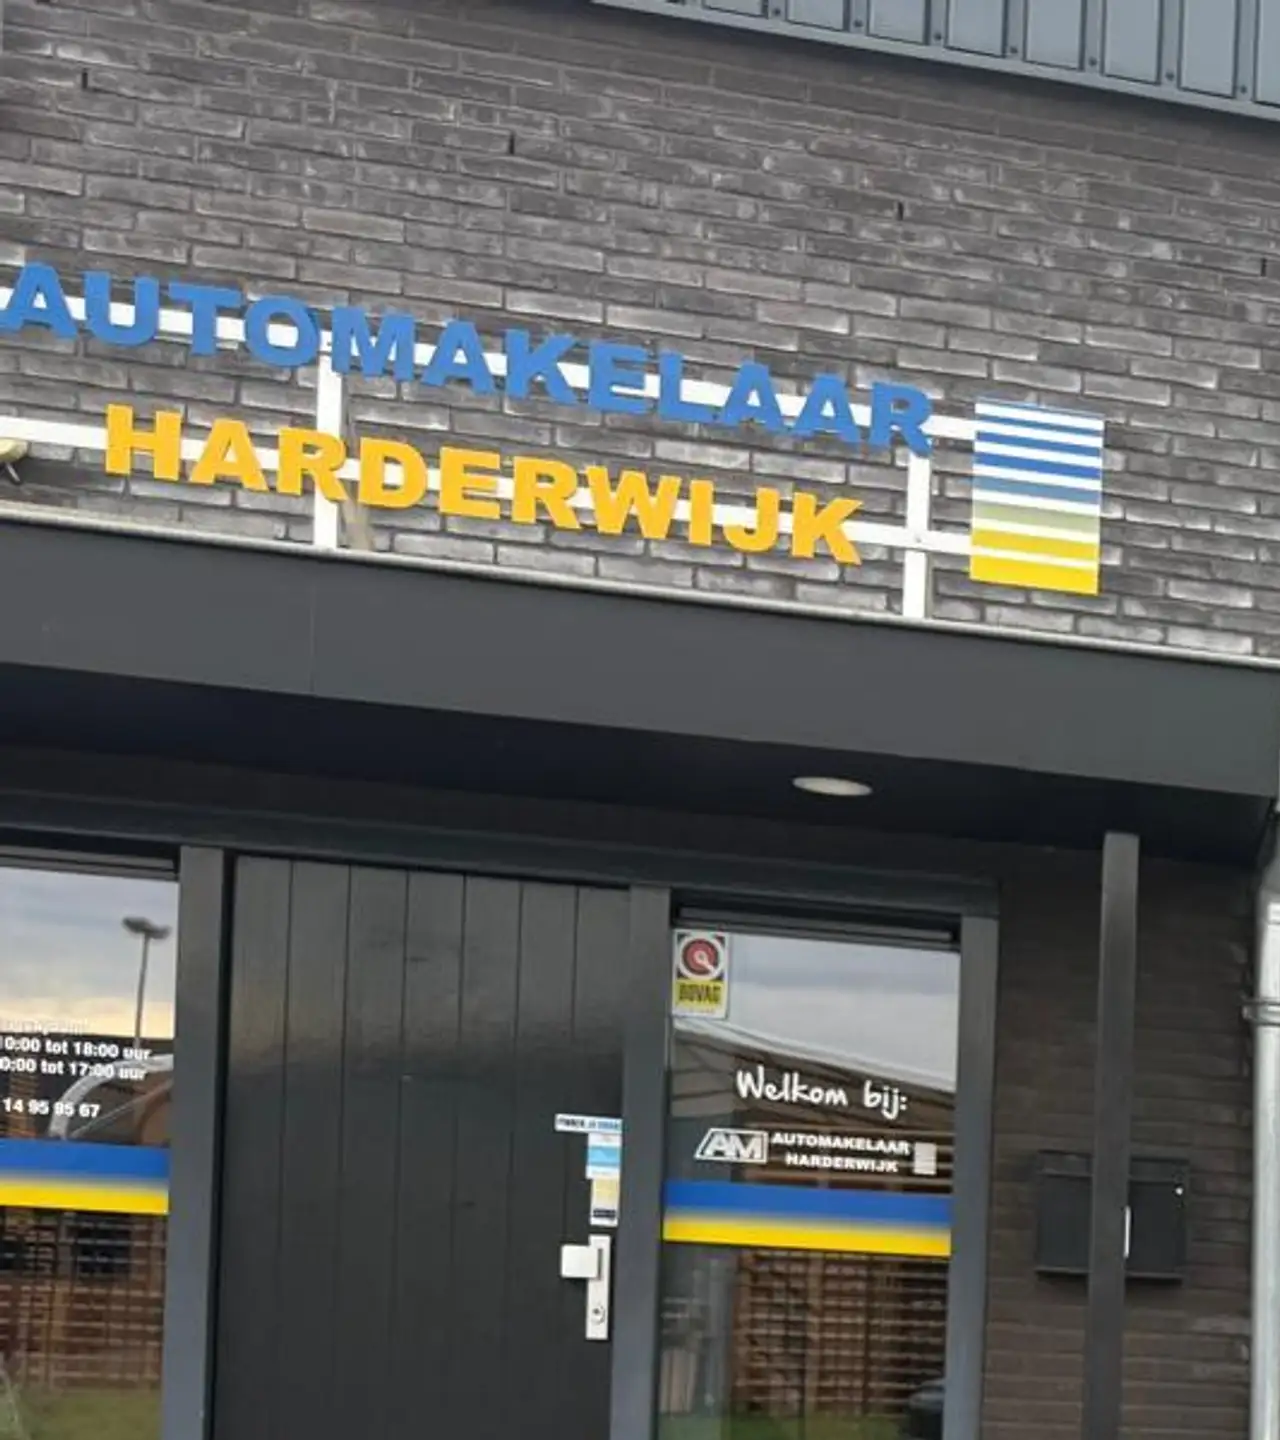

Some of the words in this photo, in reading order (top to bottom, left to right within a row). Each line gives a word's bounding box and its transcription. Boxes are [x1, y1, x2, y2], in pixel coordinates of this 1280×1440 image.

[0, 262, 932, 455] AUTOMAKELAAR
[104, 403, 863, 566] HARDERWIJK
[45, 1040, 69, 1055] tot
[73, 1042, 119, 1058] 18:00
[122, 1048, 152, 1060] uur
[40, 1060, 64, 1075] tot
[118, 1067, 148, 1080] uur
[736, 1065, 848, 1107] Welkom
[863, 1080, 908, 1120] bij:
[3, 1098, 24, 1113] 14
[79, 1103, 101, 1118] 67
[705, 1131, 762, 1159] AM
[771, 1131, 911, 1155] AUTOMAKELAAR
[785, 1152, 898, 1172] HARDERWIJK
